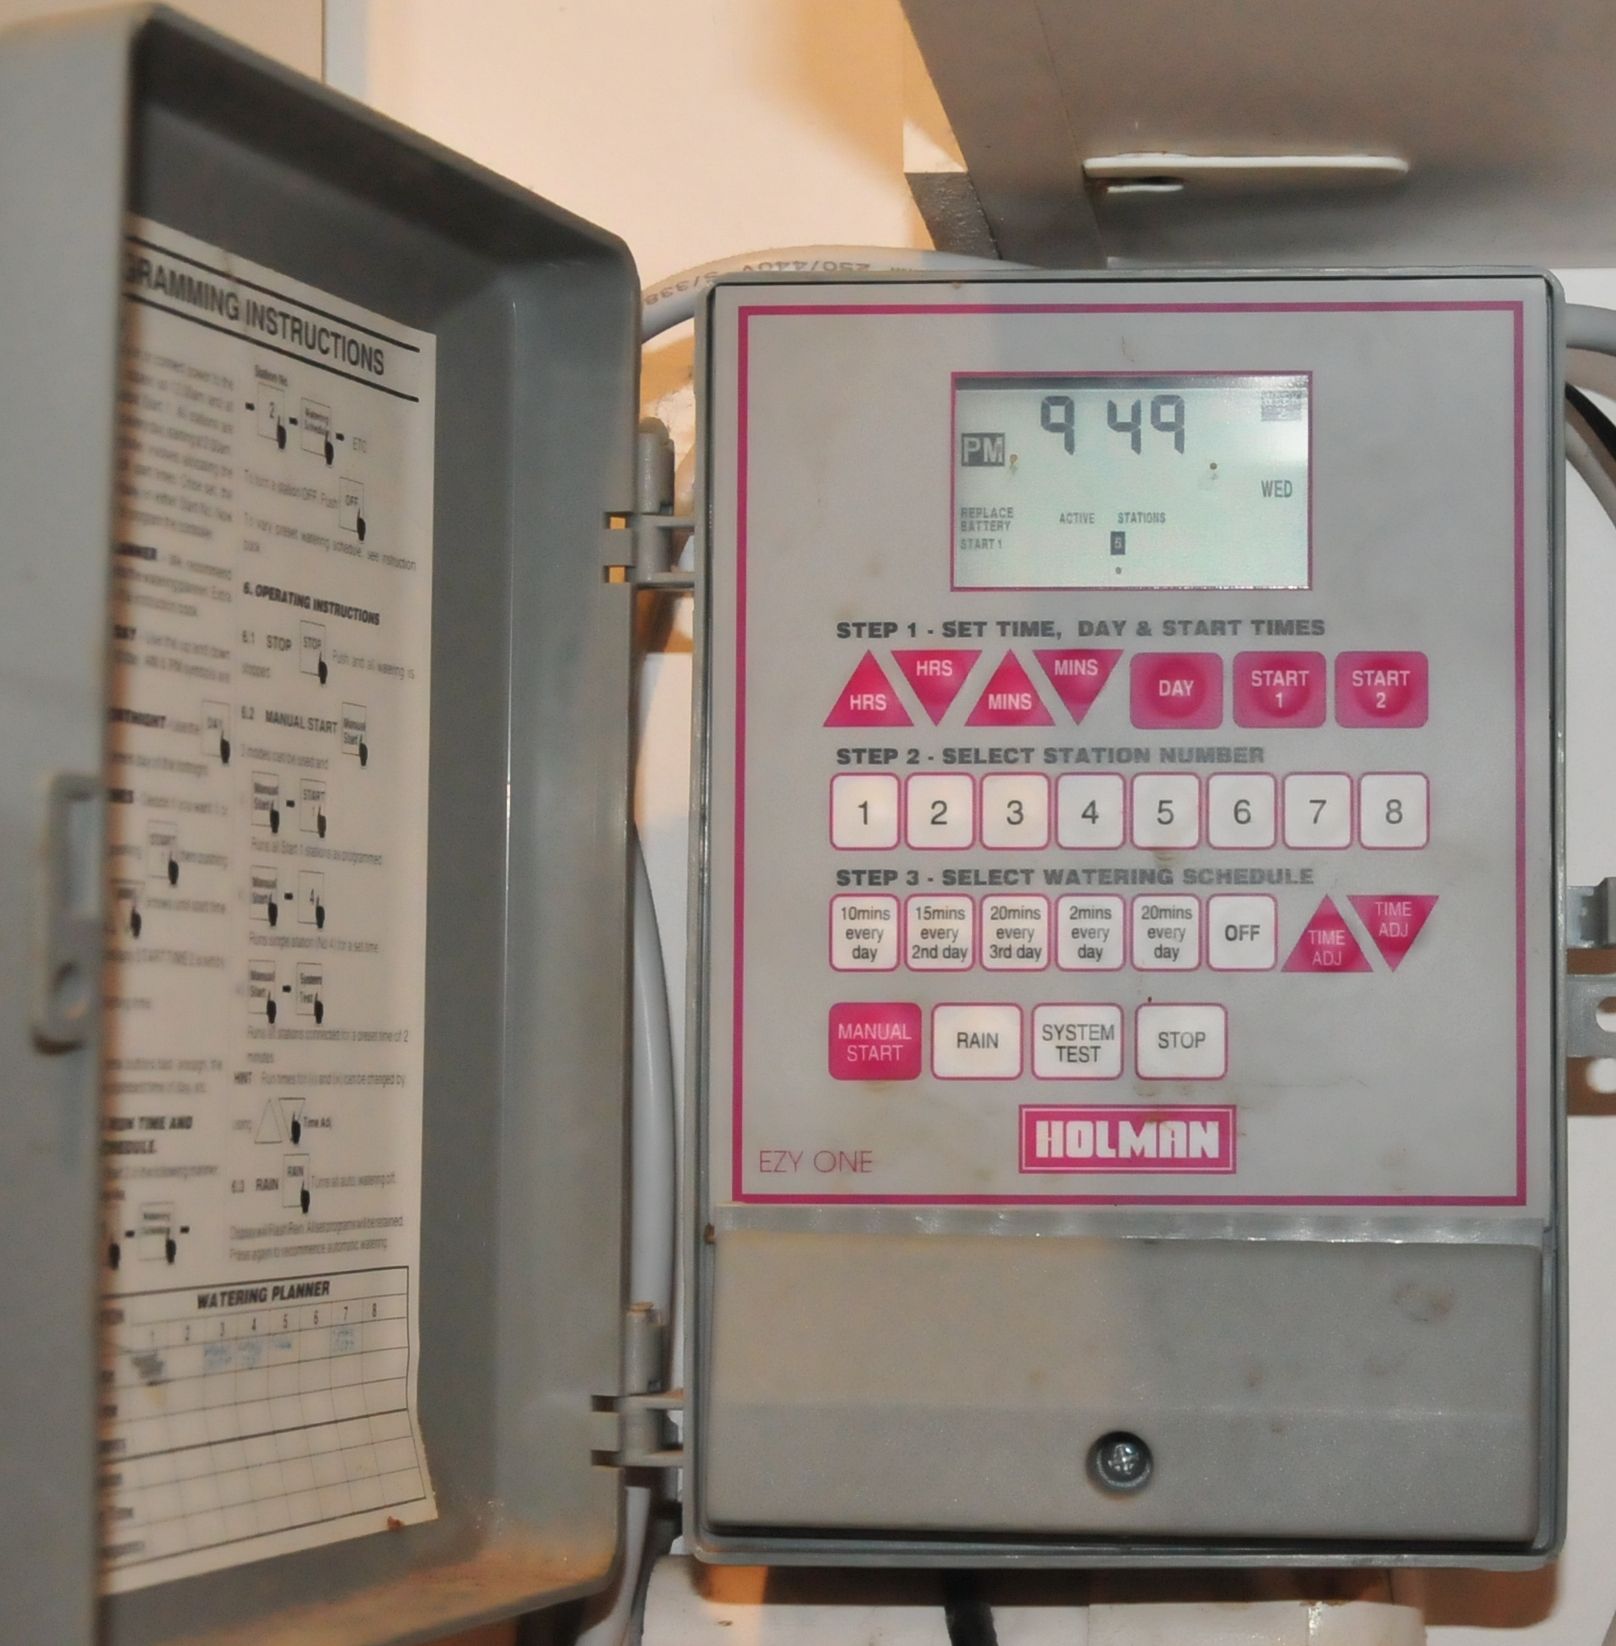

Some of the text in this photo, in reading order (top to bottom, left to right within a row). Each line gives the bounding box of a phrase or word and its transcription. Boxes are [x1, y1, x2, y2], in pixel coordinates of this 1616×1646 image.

[128, 254, 240, 321] RAMMING
[246, 300, 385, 376] INSTRUCTIONS
[1040, 394, 1185, 455] 9 49
[961, 434, 1005, 466] PM
[1261, 479, 1293, 498] WED
[960, 507, 1014, 519] REPLACE
[1059, 511, 1166, 525] ACTIVE STATIONS
[960, 520, 1011, 532] BATTERY
[960, 538, 1002, 550] START 1
[243, 581, 381, 626] 6. OPERATING INSTRUCTIONS
[836, 622, 898, 638] STEP
[906, 622, 918, 638] 1
[942, 621, 987, 638] SET
[996, 621, 1062, 640] TIME,
[1078, 621, 1126, 637] DAY
[1136, 620, 1152, 636] &
[1162, 620, 1242, 636] START
[1251, 619, 1325, 636] TIMES
[266, 634, 292, 652] STOP
[303, 635, 322, 650] STOP
[916, 660, 953, 676] HRS
[1054, 659, 1098, 676] MINS
[1251, 670, 1310, 687] START
[1352, 670, 1410, 687] START
[1159, 680, 1194, 696] DAY
[850, 694, 887, 710] HRS
[988, 693, 1032, 710] MINS
[1275, 692, 1284, 708] 1
[1376, 692, 1386, 708] 2
[265, 709, 306, 730] MANUAL
[308, 717, 339, 736] START
[836, 748, 898, 764] STEP
[906, 748, 920, 764] 2
[942, 748, 1035, 764] SELECT
[1043, 747, 1150, 764] STATION
[1159, 747, 1265, 764] NUMBER
[858, 800, 869, 825] 1
[930, 800, 948, 825] 2
[1006, 800, 1024, 825] 3
[1081, 800, 1099, 824] 4
[1156, 800, 1174, 825] 5
[1233, 799, 1251, 825] 6
[1309, 799, 1327, 824] 7
[1385, 799, 1403, 824] 8
[836, 870, 898, 886] STEP
[906, 870, 919, 886] 3
[942, 869, 1035, 886] SELECT
[1043, 868, 1174, 885] WATERING
[1182, 868, 1314, 885] SCHEDULE
[841, 906, 891, 920] 10mins
[916, 906, 966, 920] 15mins
[990, 906, 1041, 920] 20mins
[1069, 906, 1112, 920] 2mins
[1141, 905, 1193, 920] 20mins
[1375, 902, 1412, 917] TIME
[846, 928, 884, 942] every
[920, 928, 959, 942] every
[996, 928, 1034, 942] every
[1071, 928, 1109, 942] every
[1147, 927, 1186, 942] every
[1225, 924, 1261, 941] OFF
[1308, 930, 1345, 945] TIME
[1379, 922, 1409, 938] ADJ
[852, 945, 877, 962] day
[912, 945, 968, 962] 2nd day
[990, 945, 1042, 962] 3rd day
[1078, 945, 1103, 962] day
[1154, 944, 1180, 962] day
[1312, 951, 1342, 966] ADJ
[838, 1024, 912, 1040] MANUAL
[957, 1032, 998, 1049] RAIN
[1042, 1025, 1115, 1041] SYSTEM
[1158, 1032, 1206, 1049] STOP
[847, 1046, 903, 1062] START
[1056, 1046, 1101, 1063] TEST
[1035, 1119, 1220, 1159] HOLMAN
[759, 1150, 874, 1173] EZY ONE
[256, 1178, 279, 1191] RAIN
[197, 1280, 331, 1309] WATERING PLANNER
[343, 1306, 349, 1321] 7
